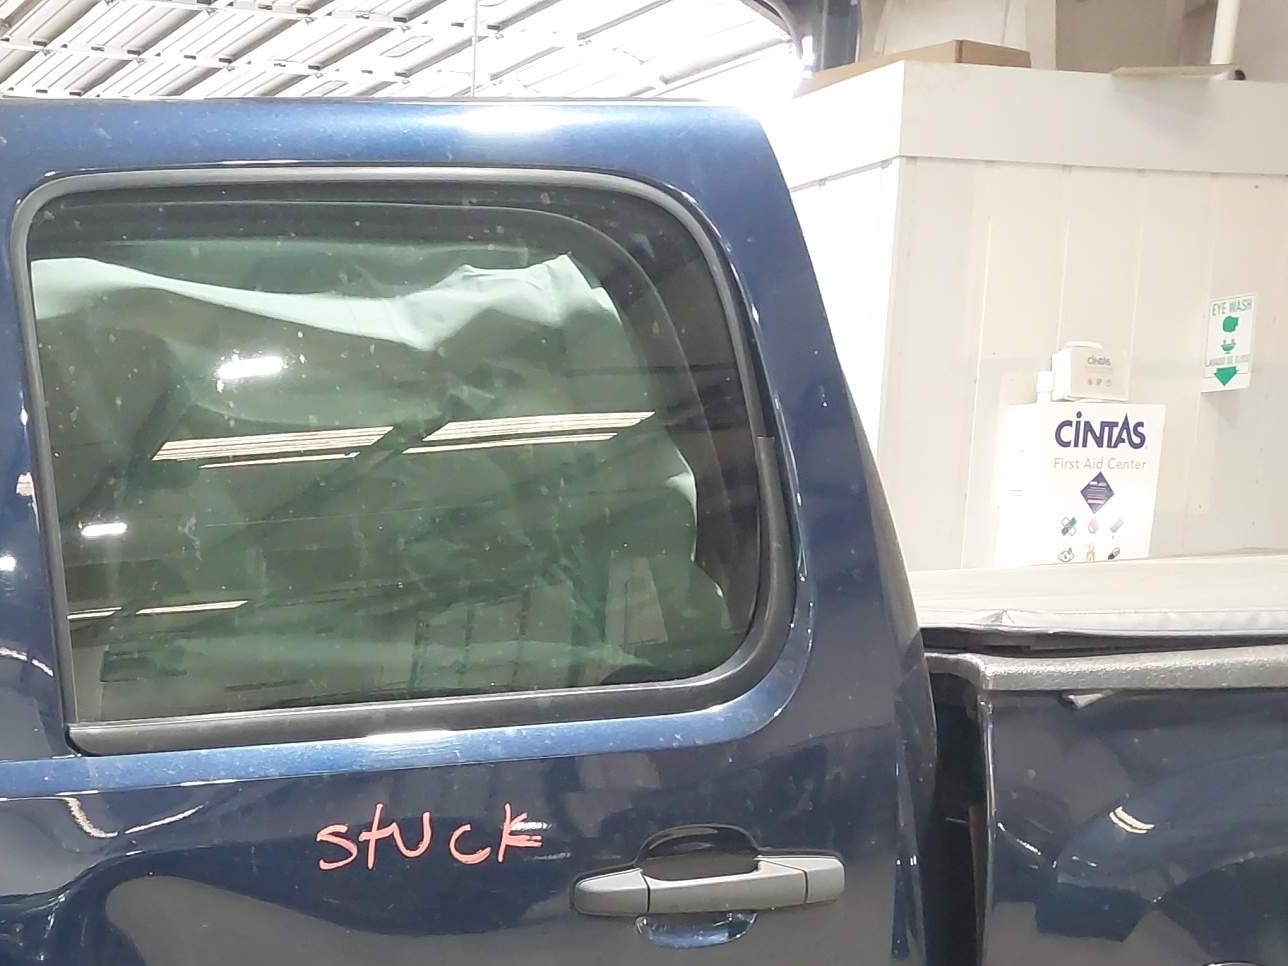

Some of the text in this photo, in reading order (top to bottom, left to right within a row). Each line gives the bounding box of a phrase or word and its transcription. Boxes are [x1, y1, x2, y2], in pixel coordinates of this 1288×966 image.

[1212, 298, 1252, 316] EYE WASH
[1053, 457, 1147, 470] First Aid Center
